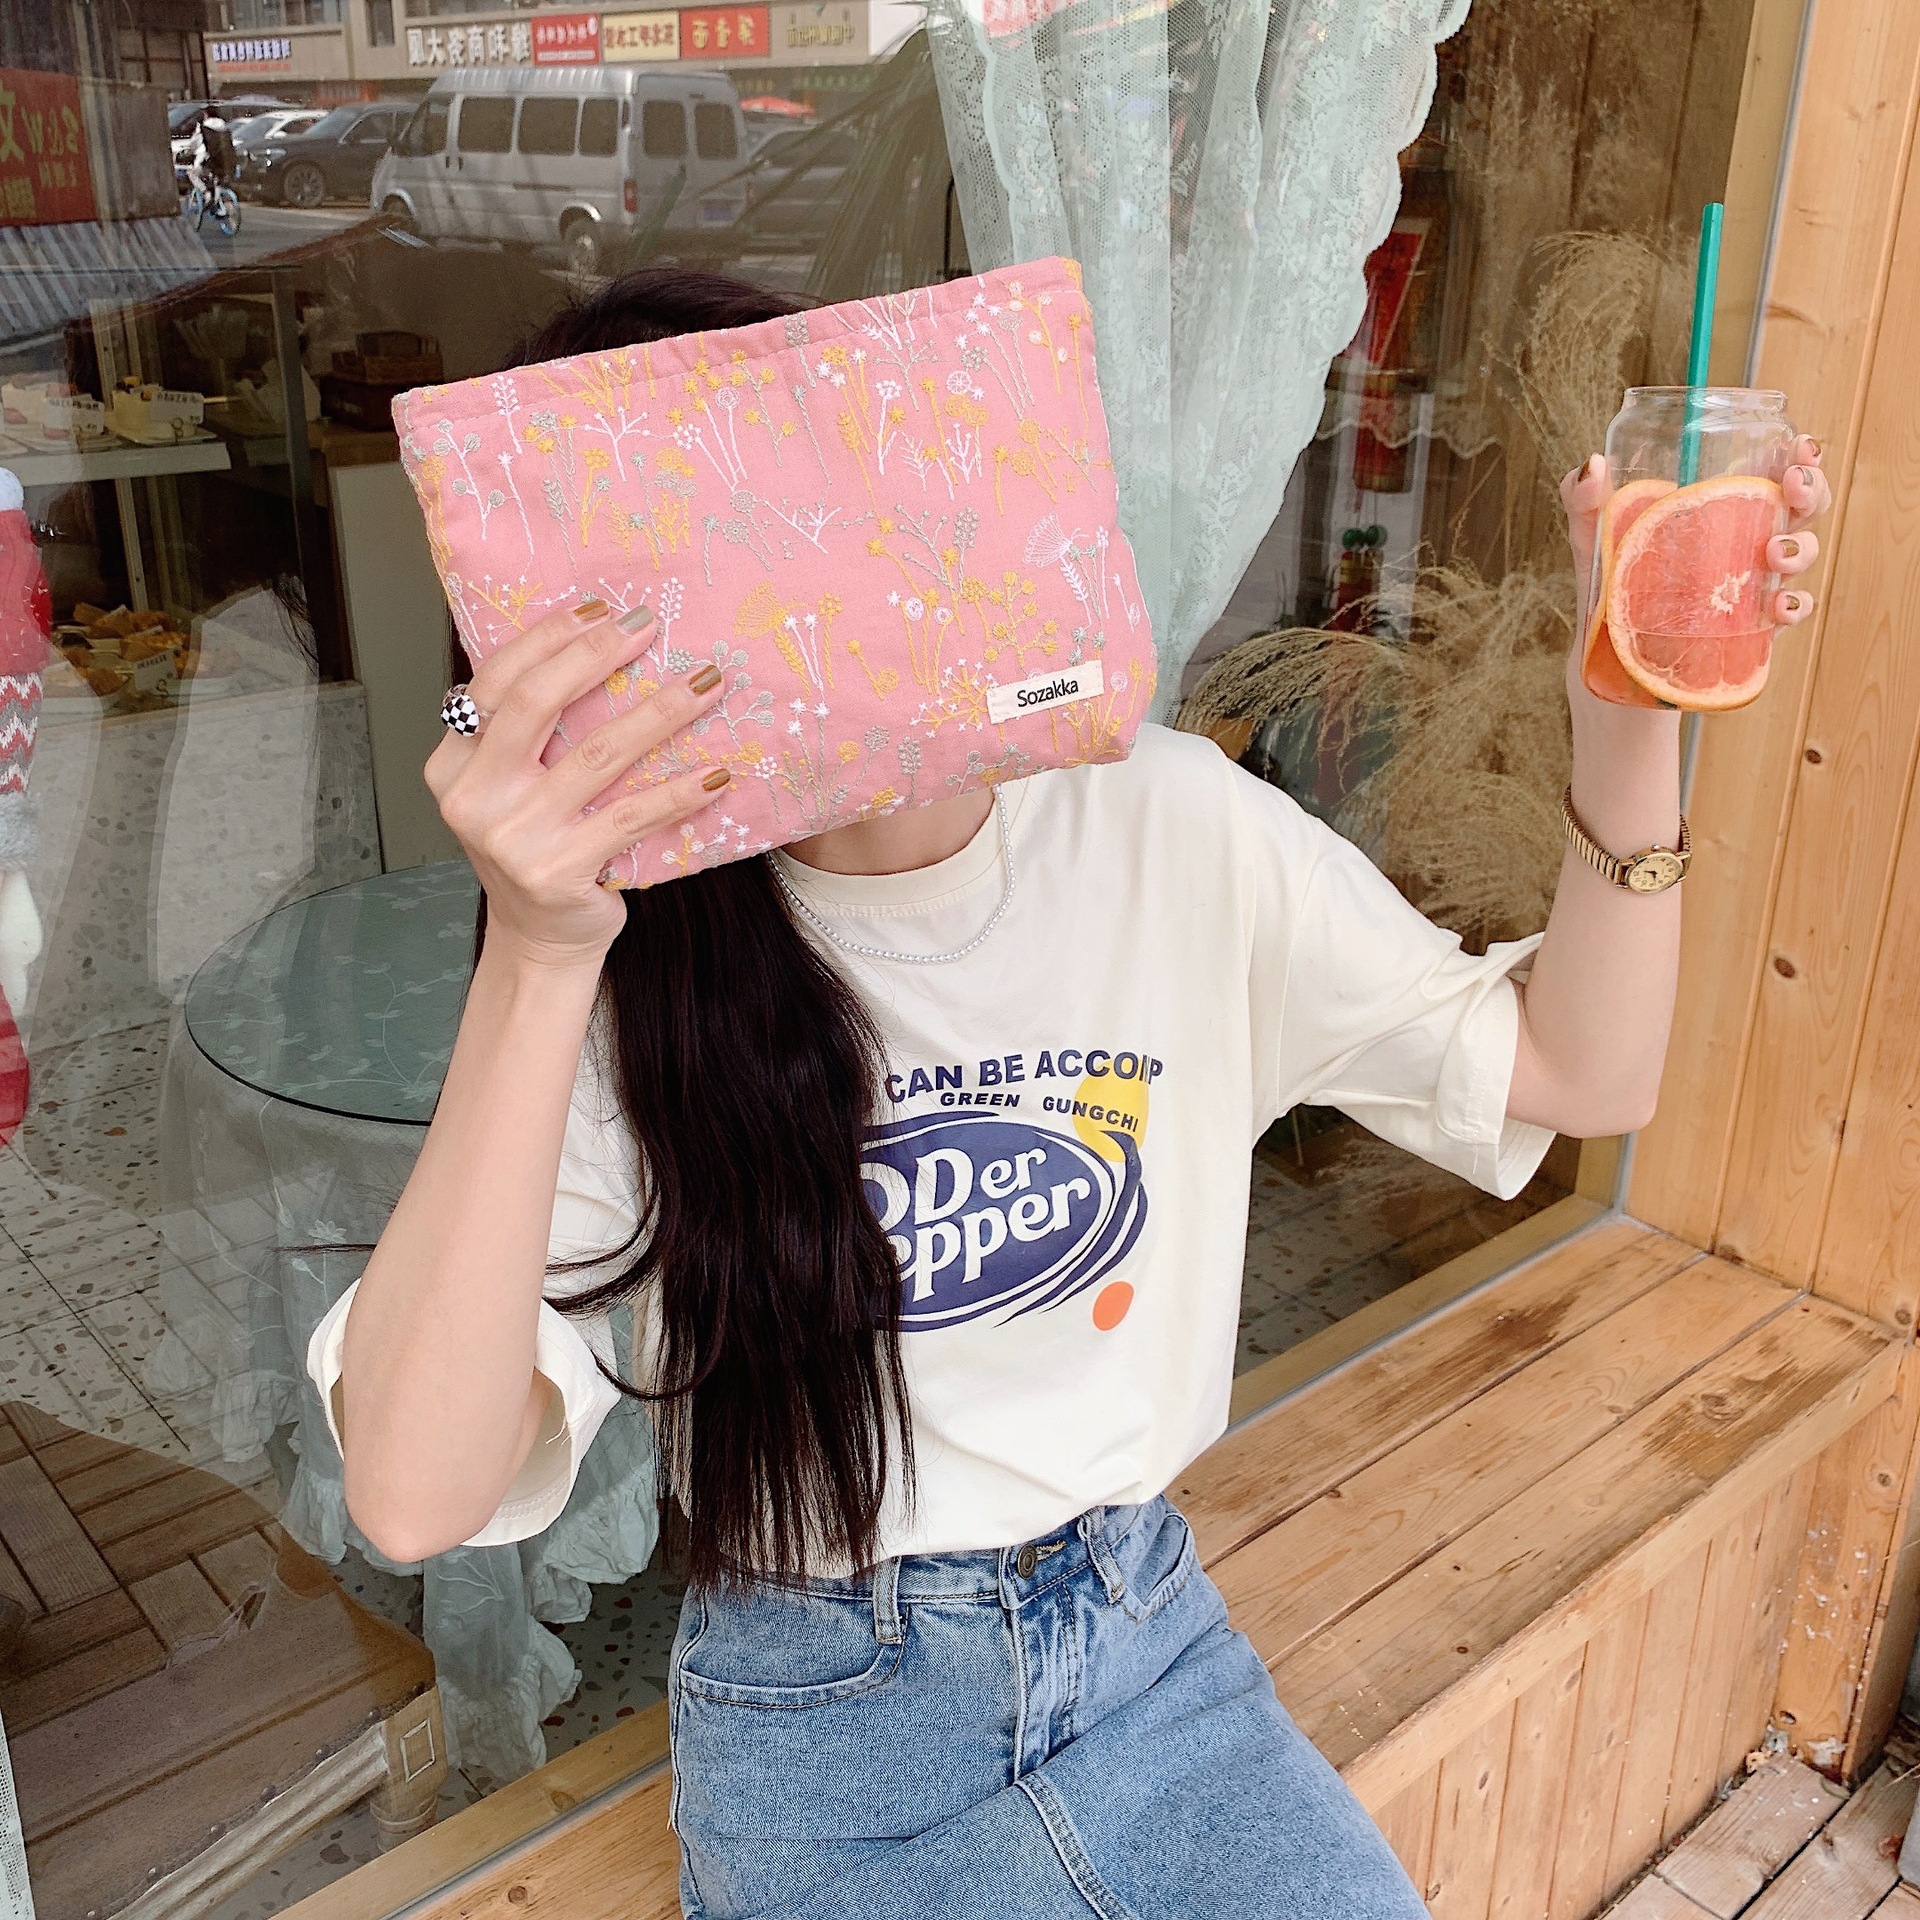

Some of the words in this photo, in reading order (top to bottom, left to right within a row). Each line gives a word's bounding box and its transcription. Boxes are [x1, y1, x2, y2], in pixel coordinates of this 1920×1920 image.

[1017, 678, 1079, 707] Sozakka
[884, 1065, 963, 1103] CAN
[978, 1053, 1026, 1087] BE
[940, 1092, 1021, 1108] GREEN
[1042, 1096, 1139, 1132] GUNGCHI
